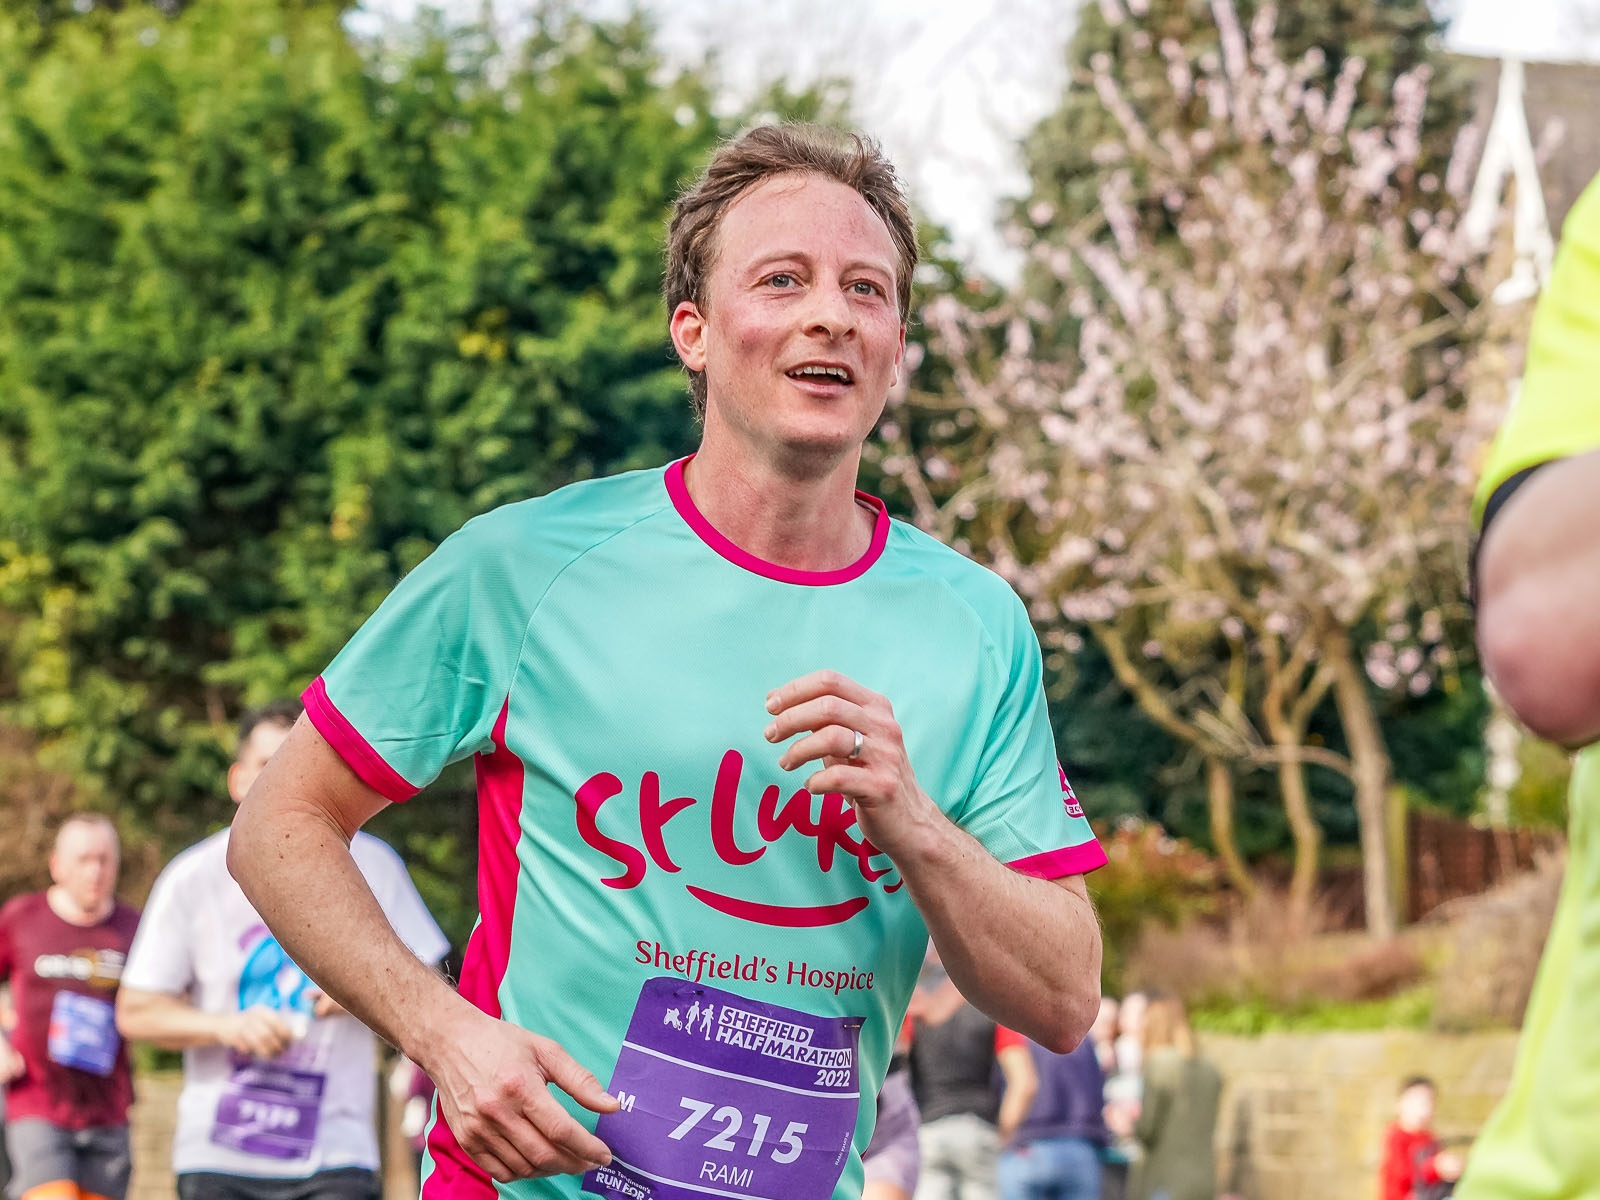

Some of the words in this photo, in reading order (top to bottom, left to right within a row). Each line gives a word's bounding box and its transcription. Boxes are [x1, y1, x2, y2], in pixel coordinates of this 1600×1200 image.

[574, 771, 698, 890] St
[635, 940, 778, 982] Sheffield's
[787, 961, 874, 995] Hospice
[720, 1008, 811, 1044] SHEFFIELD
[715, 1026, 765, 1051] HALF
[764, 1039, 851, 1067] MARATHON
[813, 1069, 850, 1087] 2022
[667, 1096, 809, 1164] 7215
[595, 1172, 622, 1190] RUN
[699, 1161, 754, 1188] RAMI
